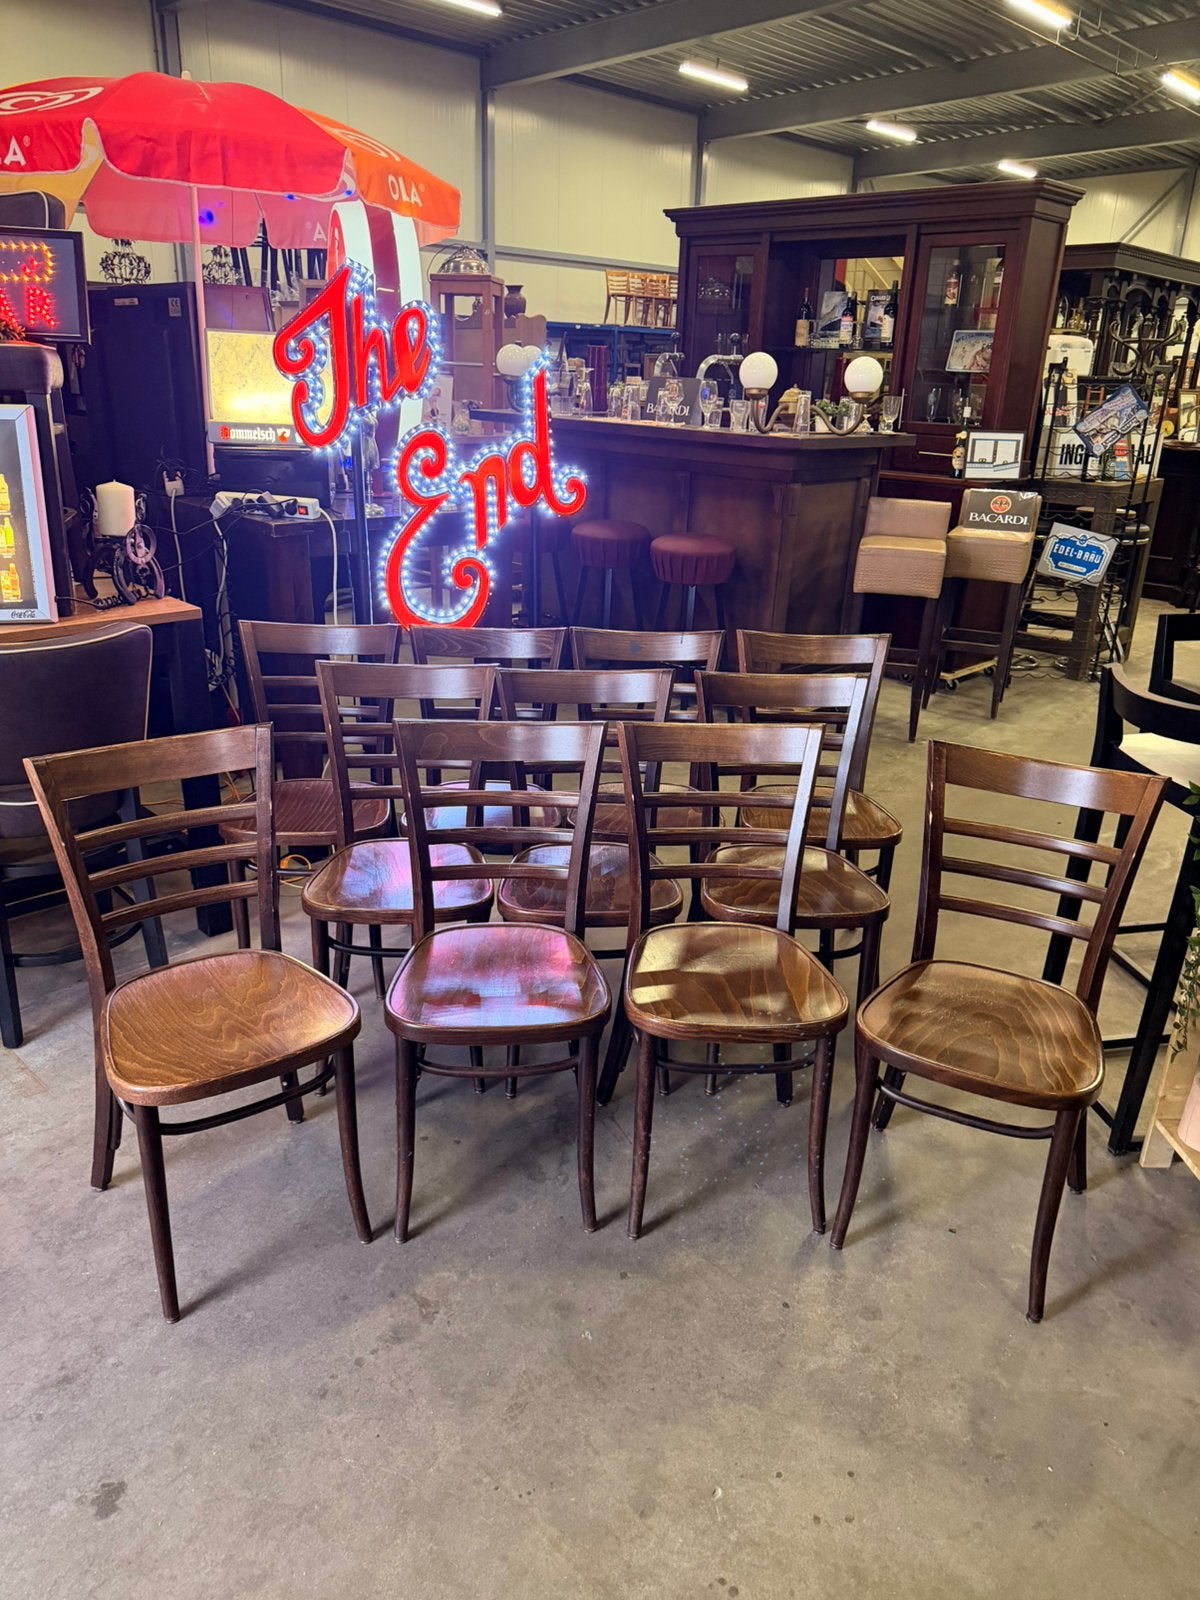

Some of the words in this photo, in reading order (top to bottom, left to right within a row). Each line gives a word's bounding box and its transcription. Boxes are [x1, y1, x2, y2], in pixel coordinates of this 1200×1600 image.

[388, 174, 423, 207] OLA
[272, 263, 436, 450] The
[382, 364, 588, 628] End
[968, 511, 1029, 526] BACARDI
[1053, 543, 1103, 564] EDEL-BRÄU
